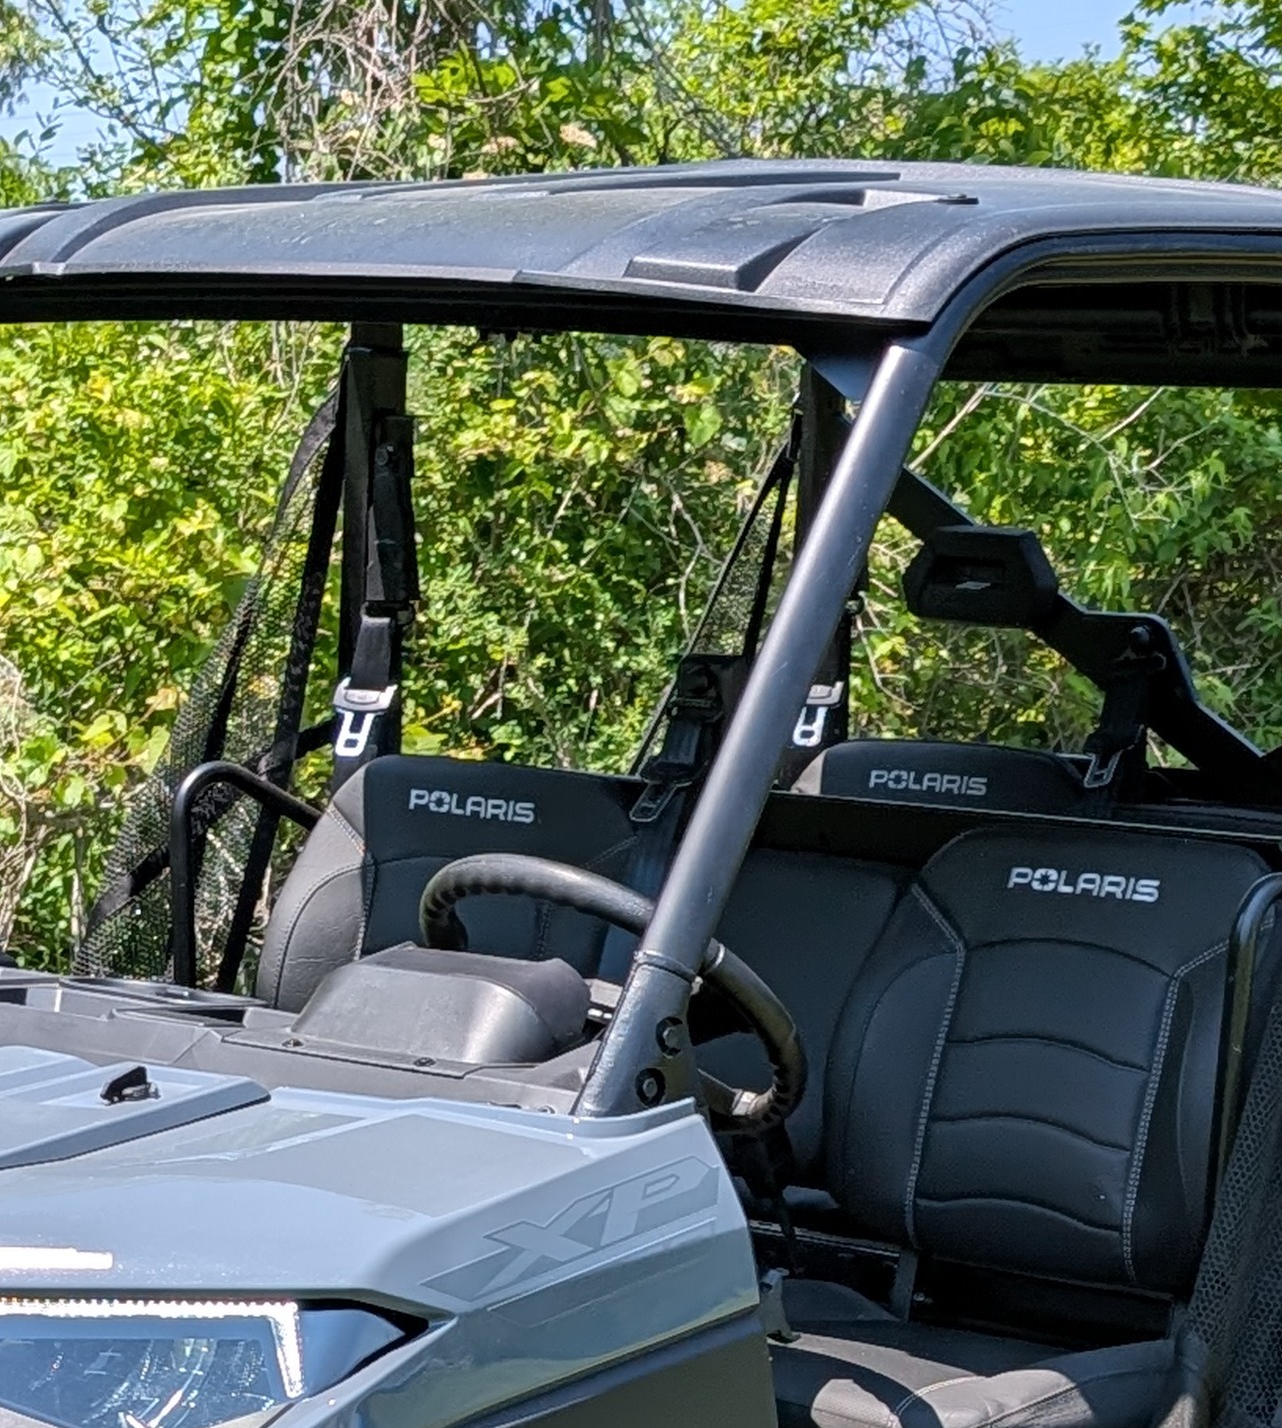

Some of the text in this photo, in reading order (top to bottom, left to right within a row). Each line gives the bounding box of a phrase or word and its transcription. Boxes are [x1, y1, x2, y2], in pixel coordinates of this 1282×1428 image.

[869, 769, 988, 796] POLARIS
[408, 788, 536, 824] POLARIS
[1007, 867, 1160, 902] POLARIS
[465, 1155, 714, 1302] XP
